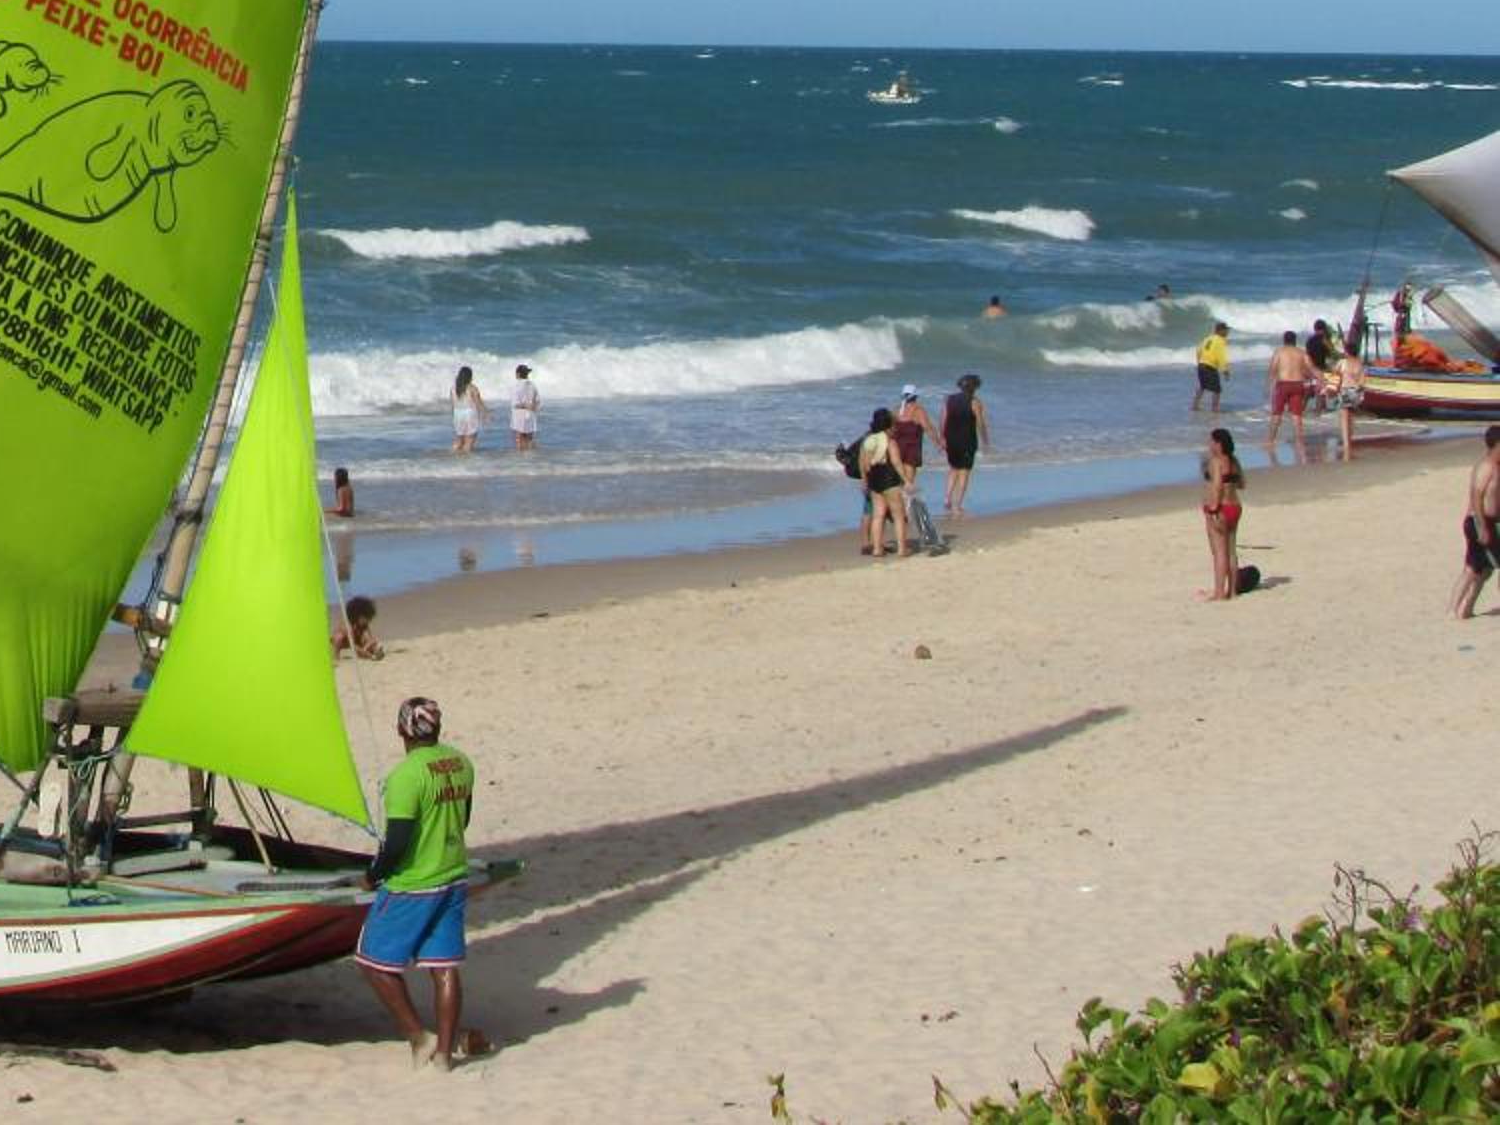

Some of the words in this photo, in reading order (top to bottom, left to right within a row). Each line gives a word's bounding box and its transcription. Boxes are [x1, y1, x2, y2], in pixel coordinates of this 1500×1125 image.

[13, 289, 33, 316] A
[34, 299, 74, 338] ONG
[71, 290, 102, 322] OU
[96, 304, 156, 361] MANDE
[151, 345, 197, 394] FOTOS
